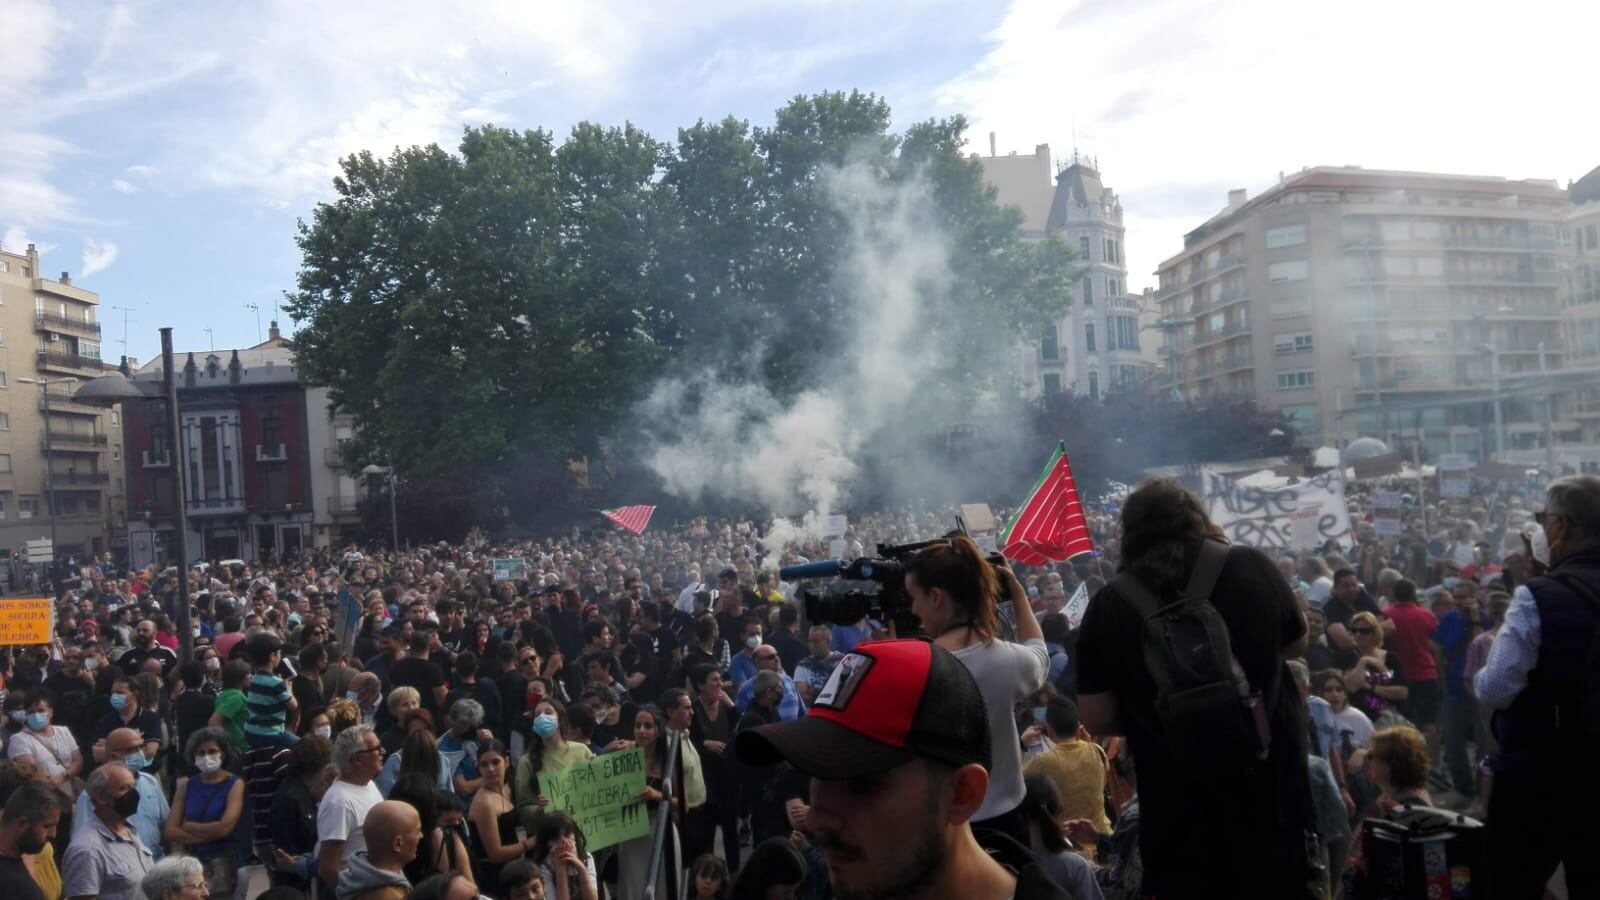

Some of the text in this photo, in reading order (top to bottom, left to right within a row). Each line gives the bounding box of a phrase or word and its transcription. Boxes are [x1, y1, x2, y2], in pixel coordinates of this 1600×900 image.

[8, 612, 45, 621] SIERRA
[18, 622, 33, 630] LA
[582, 783, 631, 811] CULEBRA
